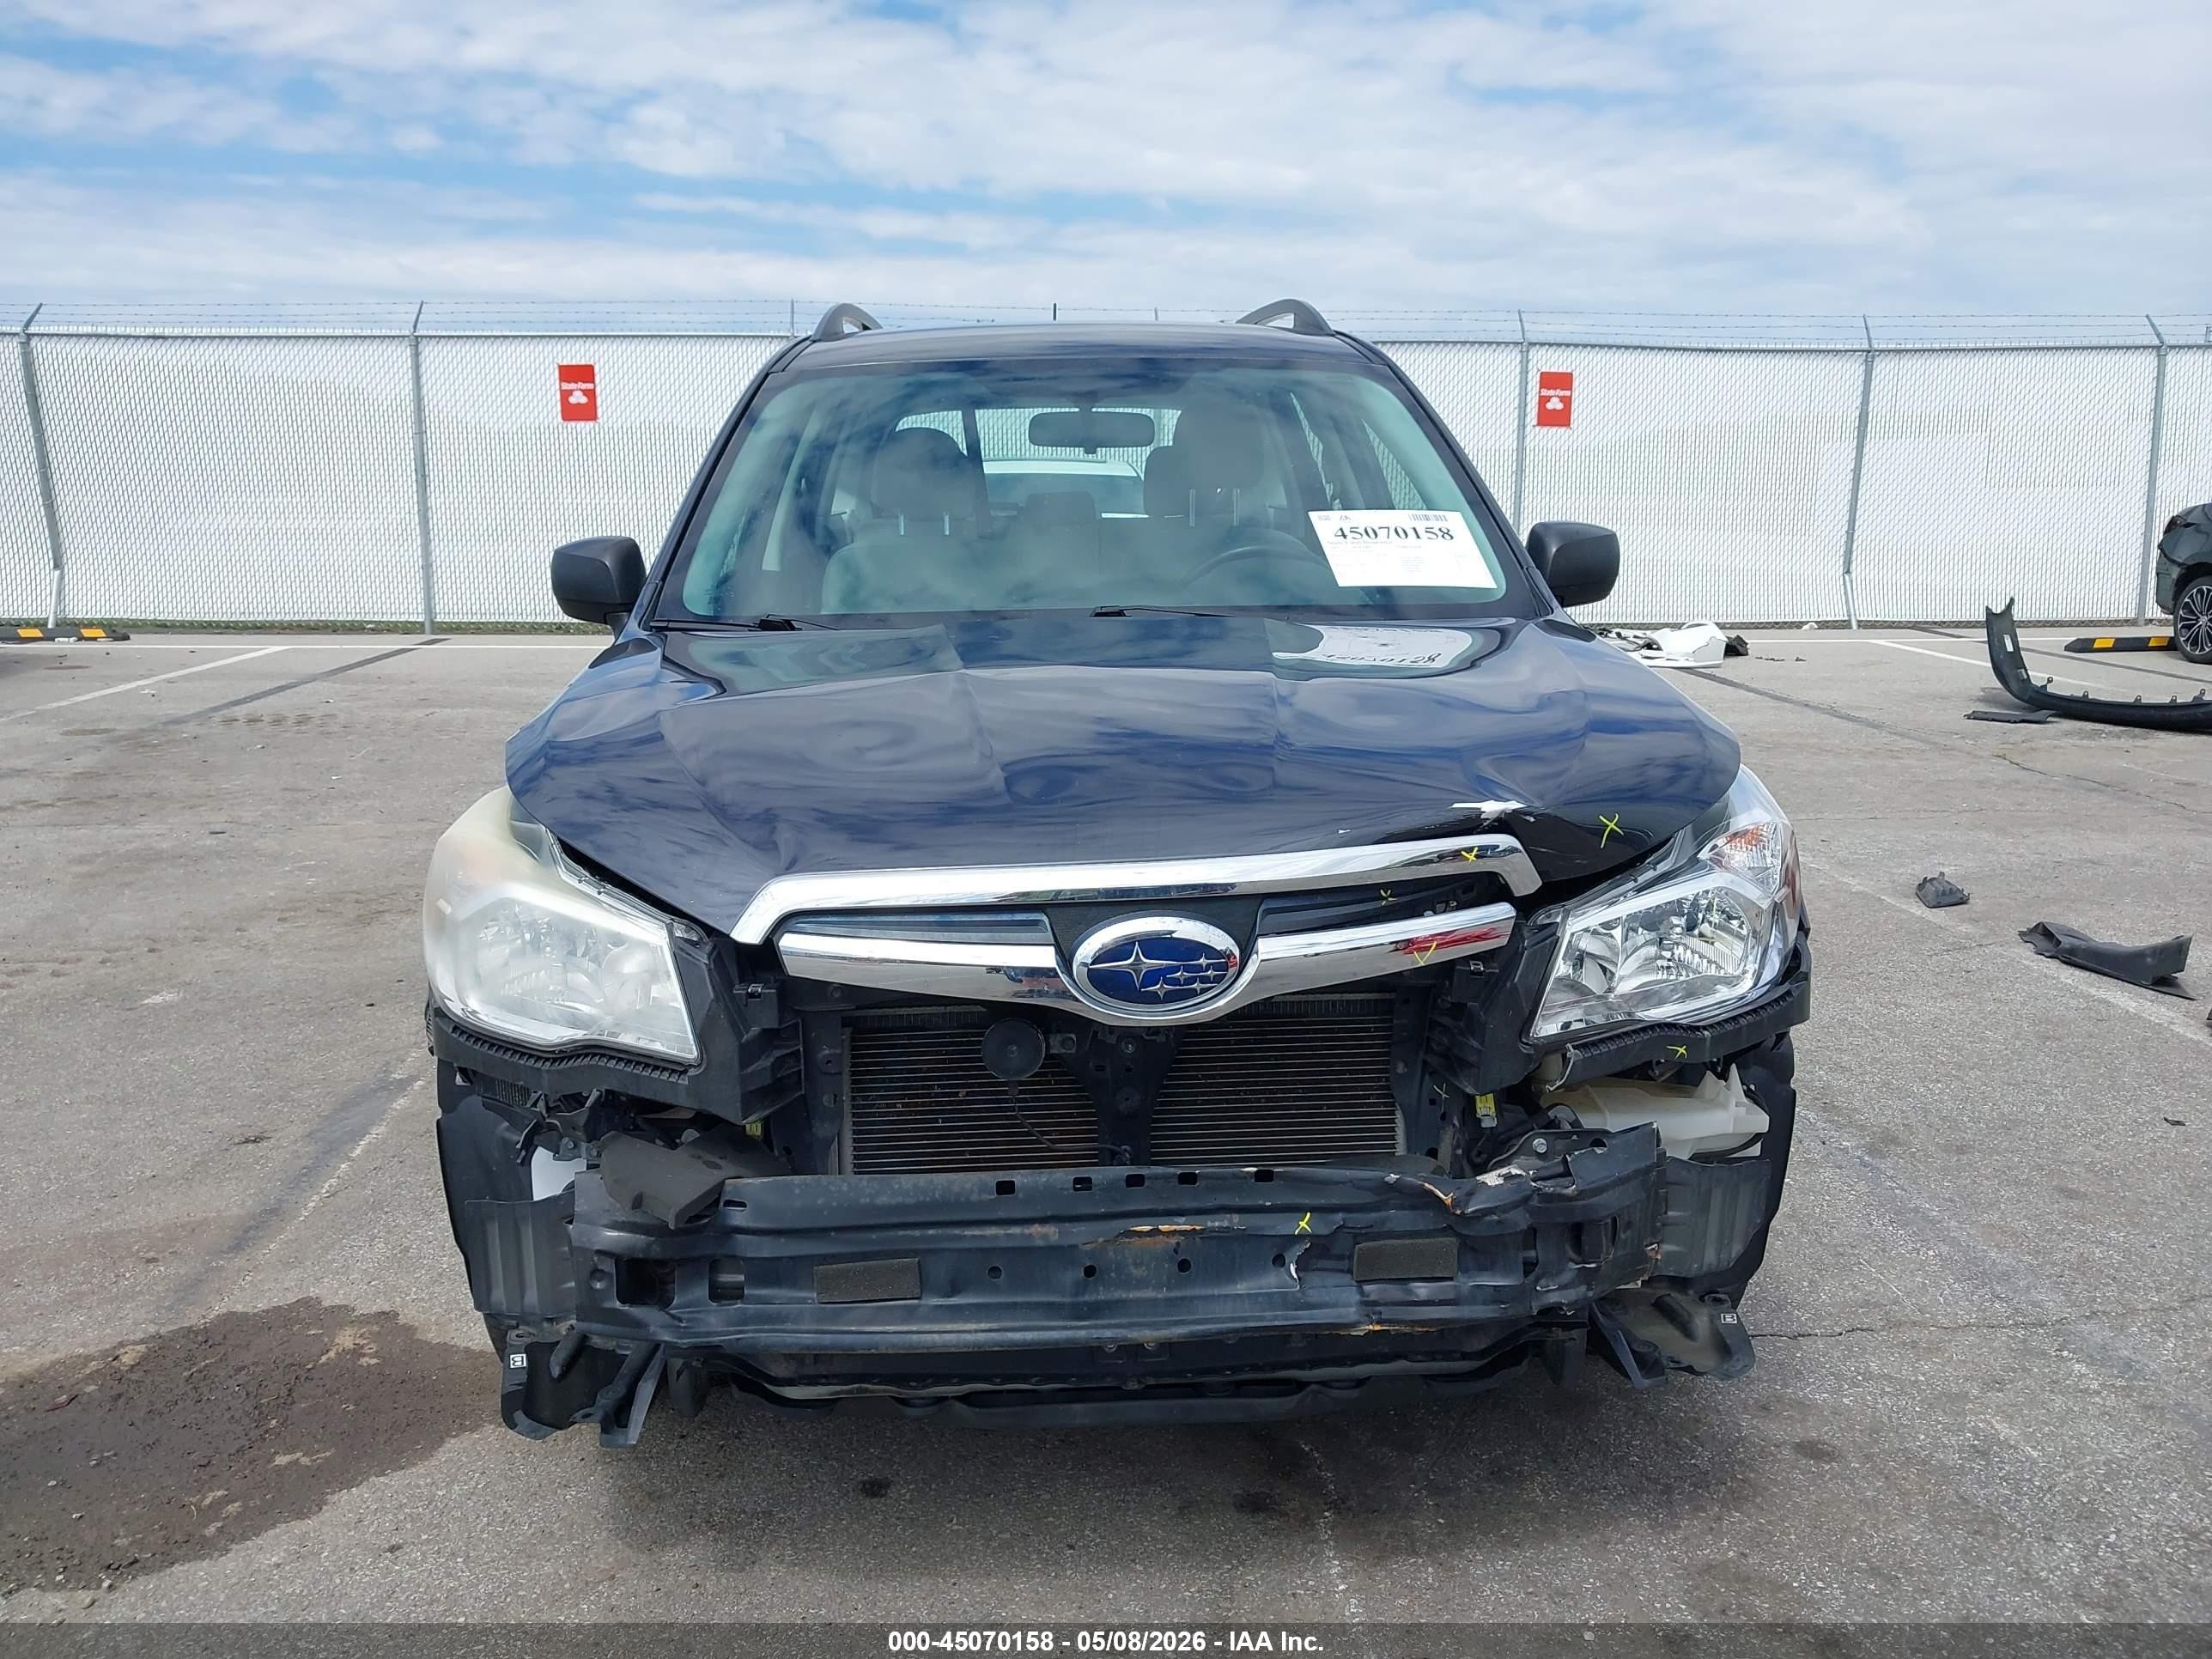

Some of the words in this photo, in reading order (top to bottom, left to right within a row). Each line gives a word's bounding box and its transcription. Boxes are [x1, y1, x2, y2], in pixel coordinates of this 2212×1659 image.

[1334, 526, 1455, 541] 45070158
[1723, 1314, 1736, 1322] B
[511, 1355, 525, 1367] B
